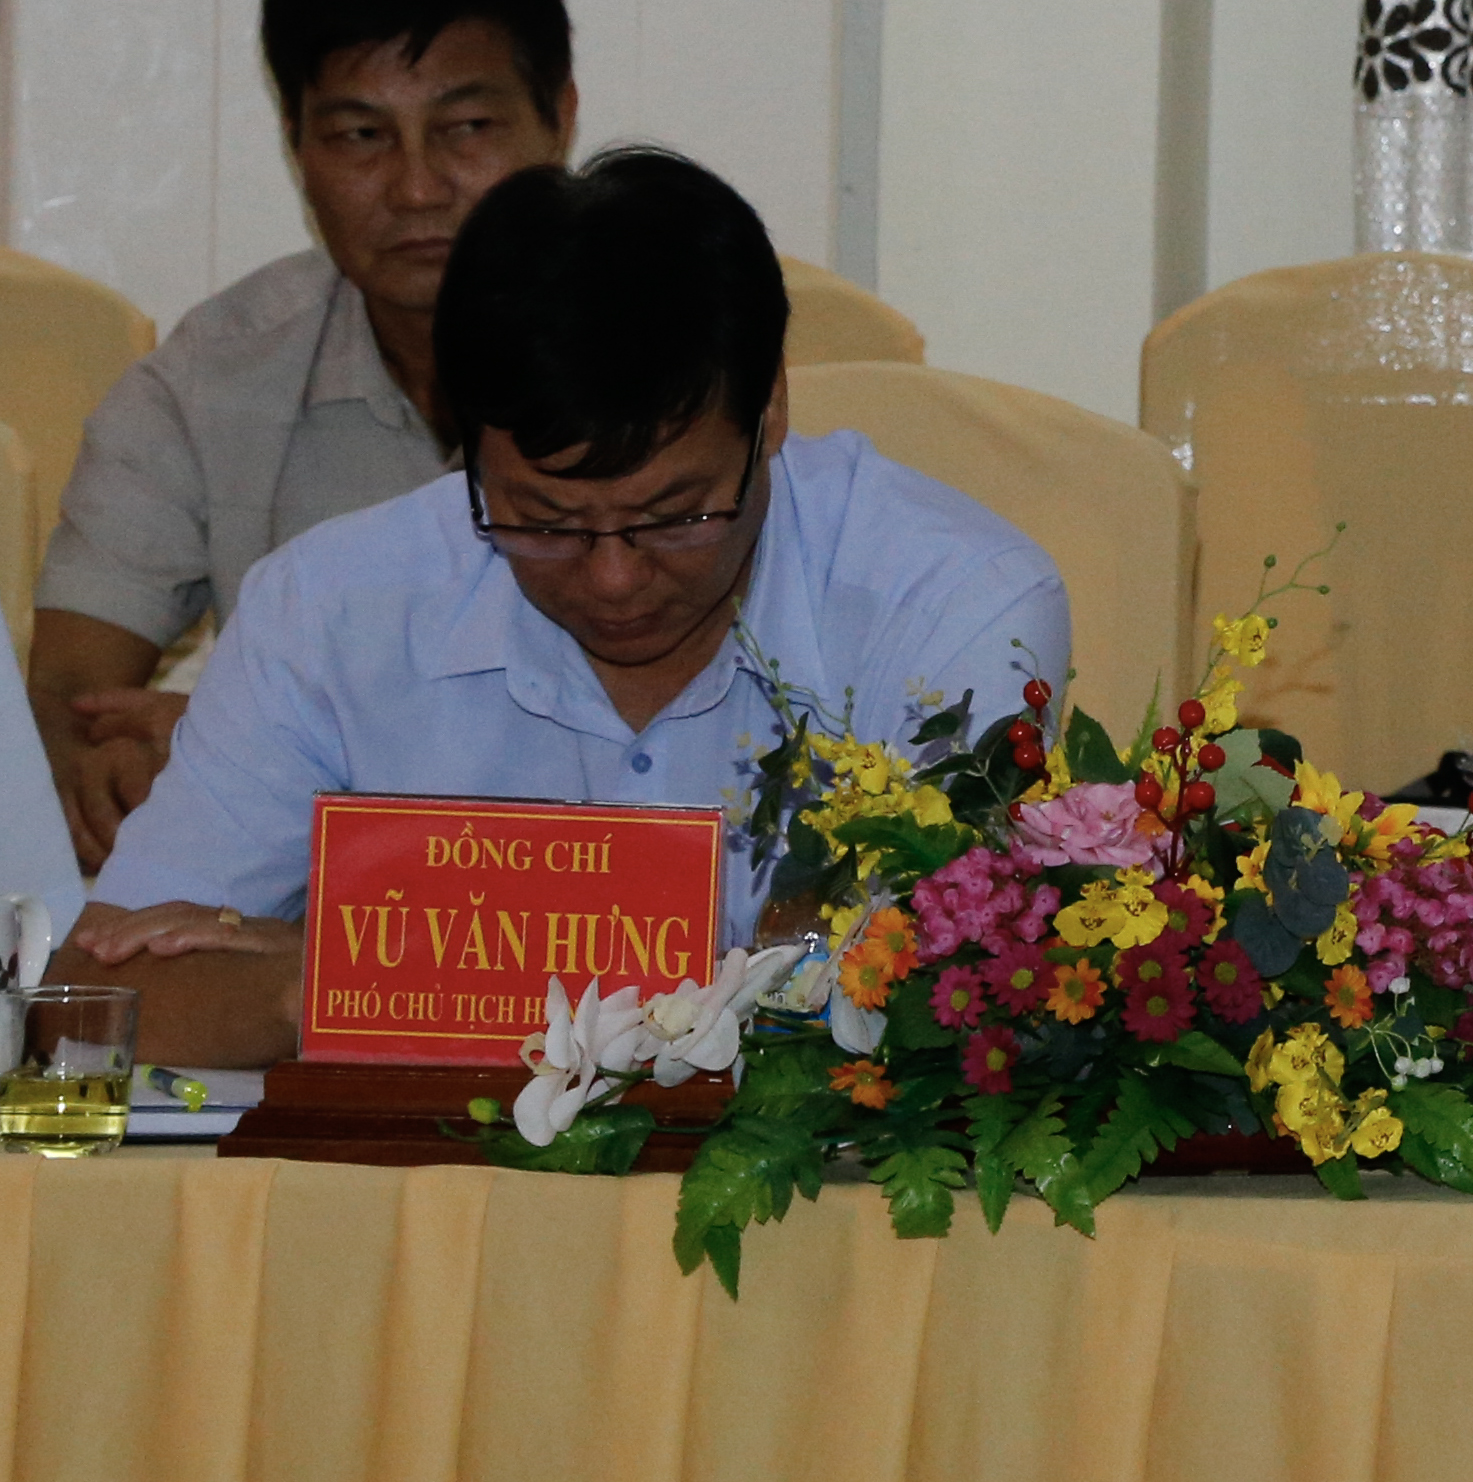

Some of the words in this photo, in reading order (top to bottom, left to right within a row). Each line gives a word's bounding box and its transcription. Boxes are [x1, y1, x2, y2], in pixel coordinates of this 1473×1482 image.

[425, 821, 534, 871] ĐỒNG
[544, 832, 613, 874] CHÍ
[338, 888, 410, 968] VŨ
[423, 891, 531, 971] VĂN
[542, 904, 691, 980] HƯNG
[327, 982, 382, 1018] PHÓ
[388, 983, 444, 1022] CHỦ
[451, 993, 516, 1031] TỊCH
